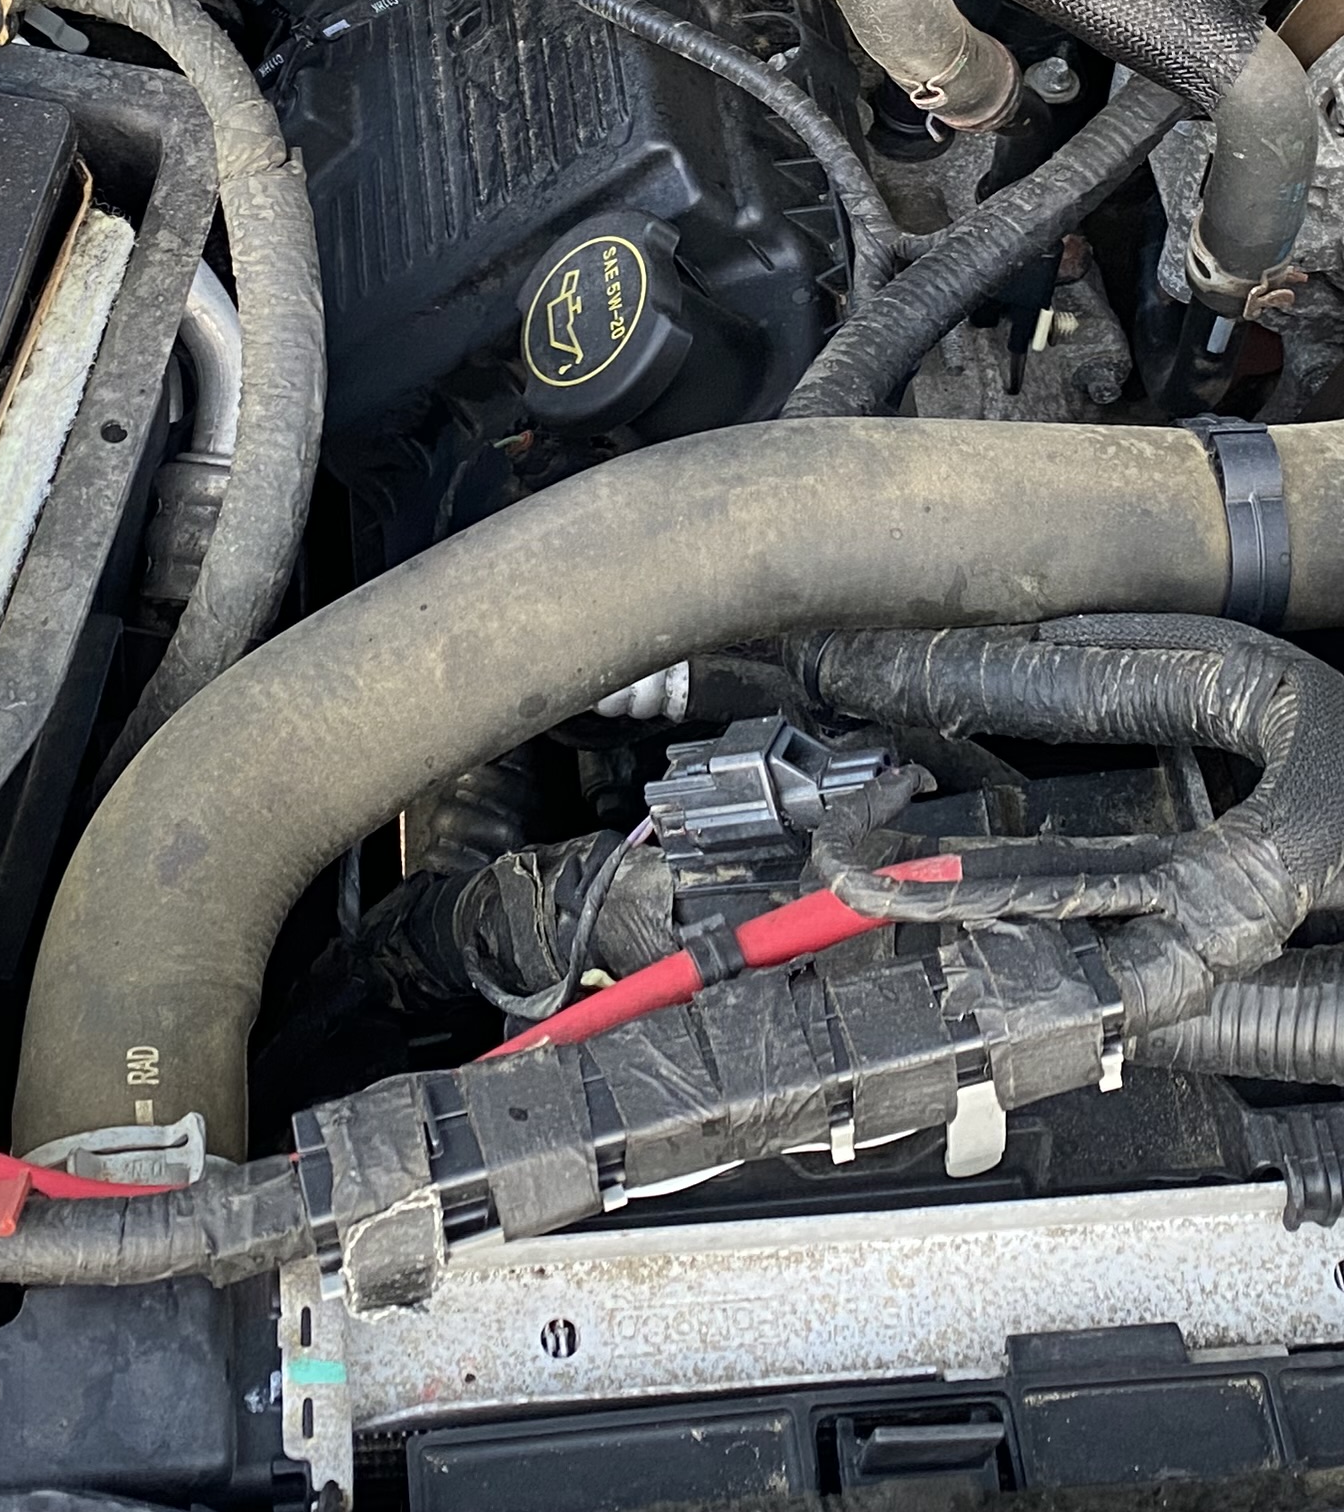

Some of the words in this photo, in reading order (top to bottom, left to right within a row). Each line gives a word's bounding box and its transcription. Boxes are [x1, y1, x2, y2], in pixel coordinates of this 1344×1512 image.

[603, 246, 619, 282] SAE
[606, 281, 626, 340] 5W-20
[126, 1046, 159, 1085] RAD
